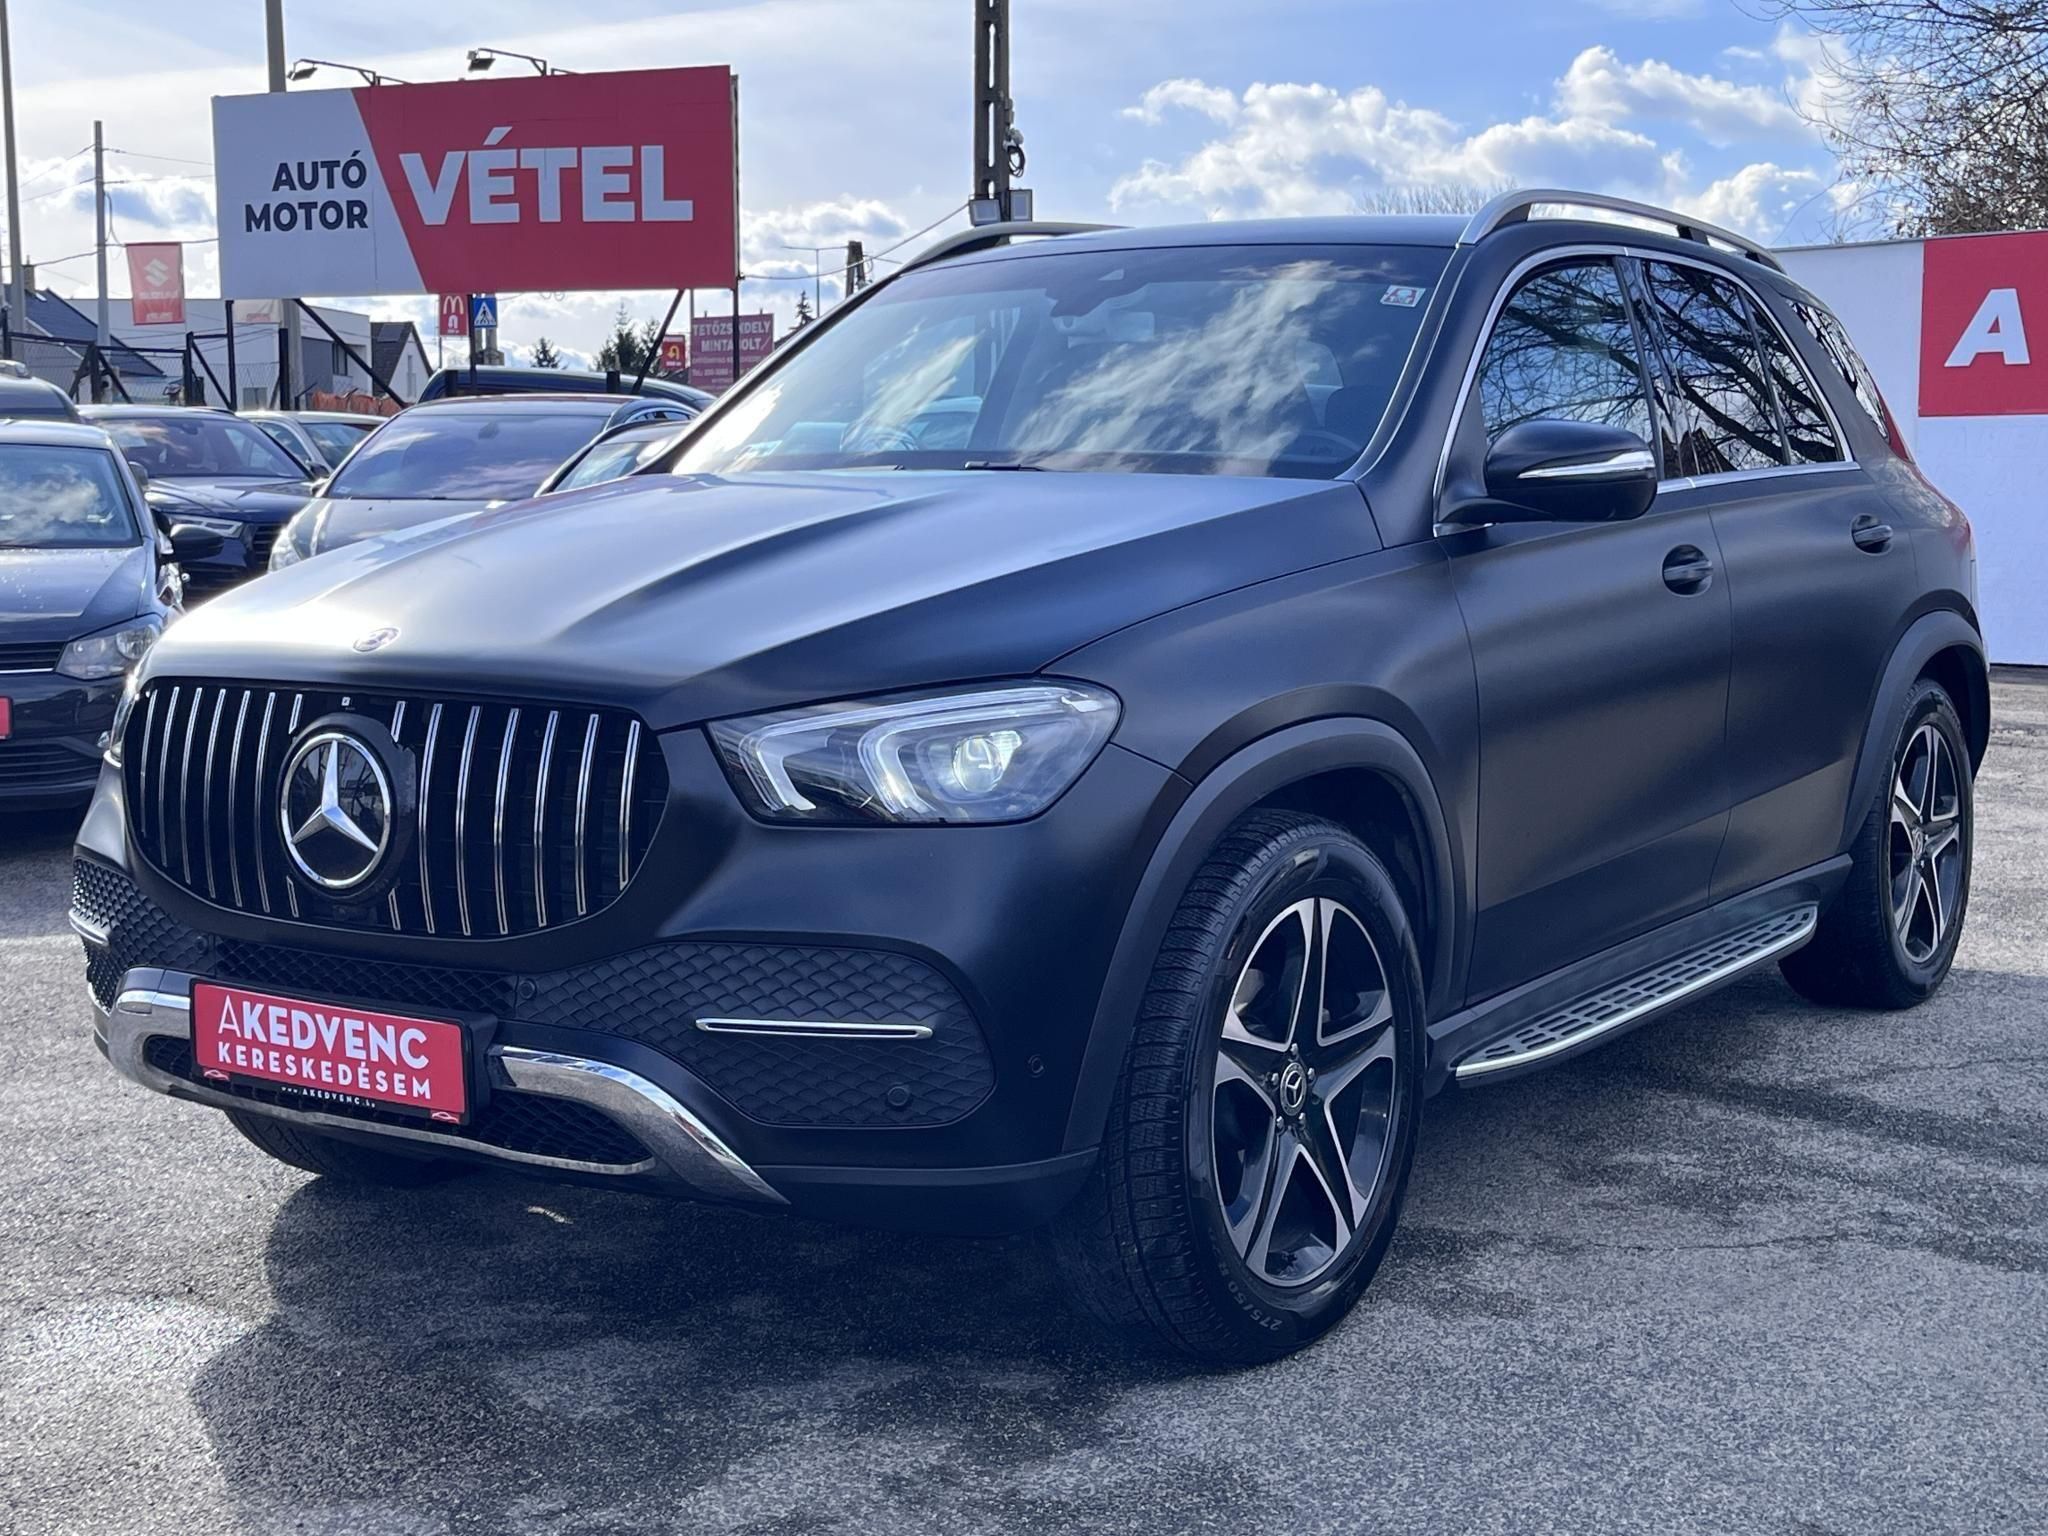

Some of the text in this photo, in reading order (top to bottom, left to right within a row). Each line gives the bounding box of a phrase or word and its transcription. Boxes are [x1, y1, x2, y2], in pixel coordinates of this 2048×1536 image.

[271, 150, 367, 191] AUTÓ
[398, 126, 694, 226] VÉTEL
[244, 200, 369, 233] MOTOR
[692, 320, 771, 336] TETŐZSNDELY
[701, 338, 762, 352] MINTAOLT
[1943, 287, 2031, 368] A
[218, 994, 430, 1070] AKEDVENC
[218, 1042, 432, 1101] KERESKEDÉSEM
